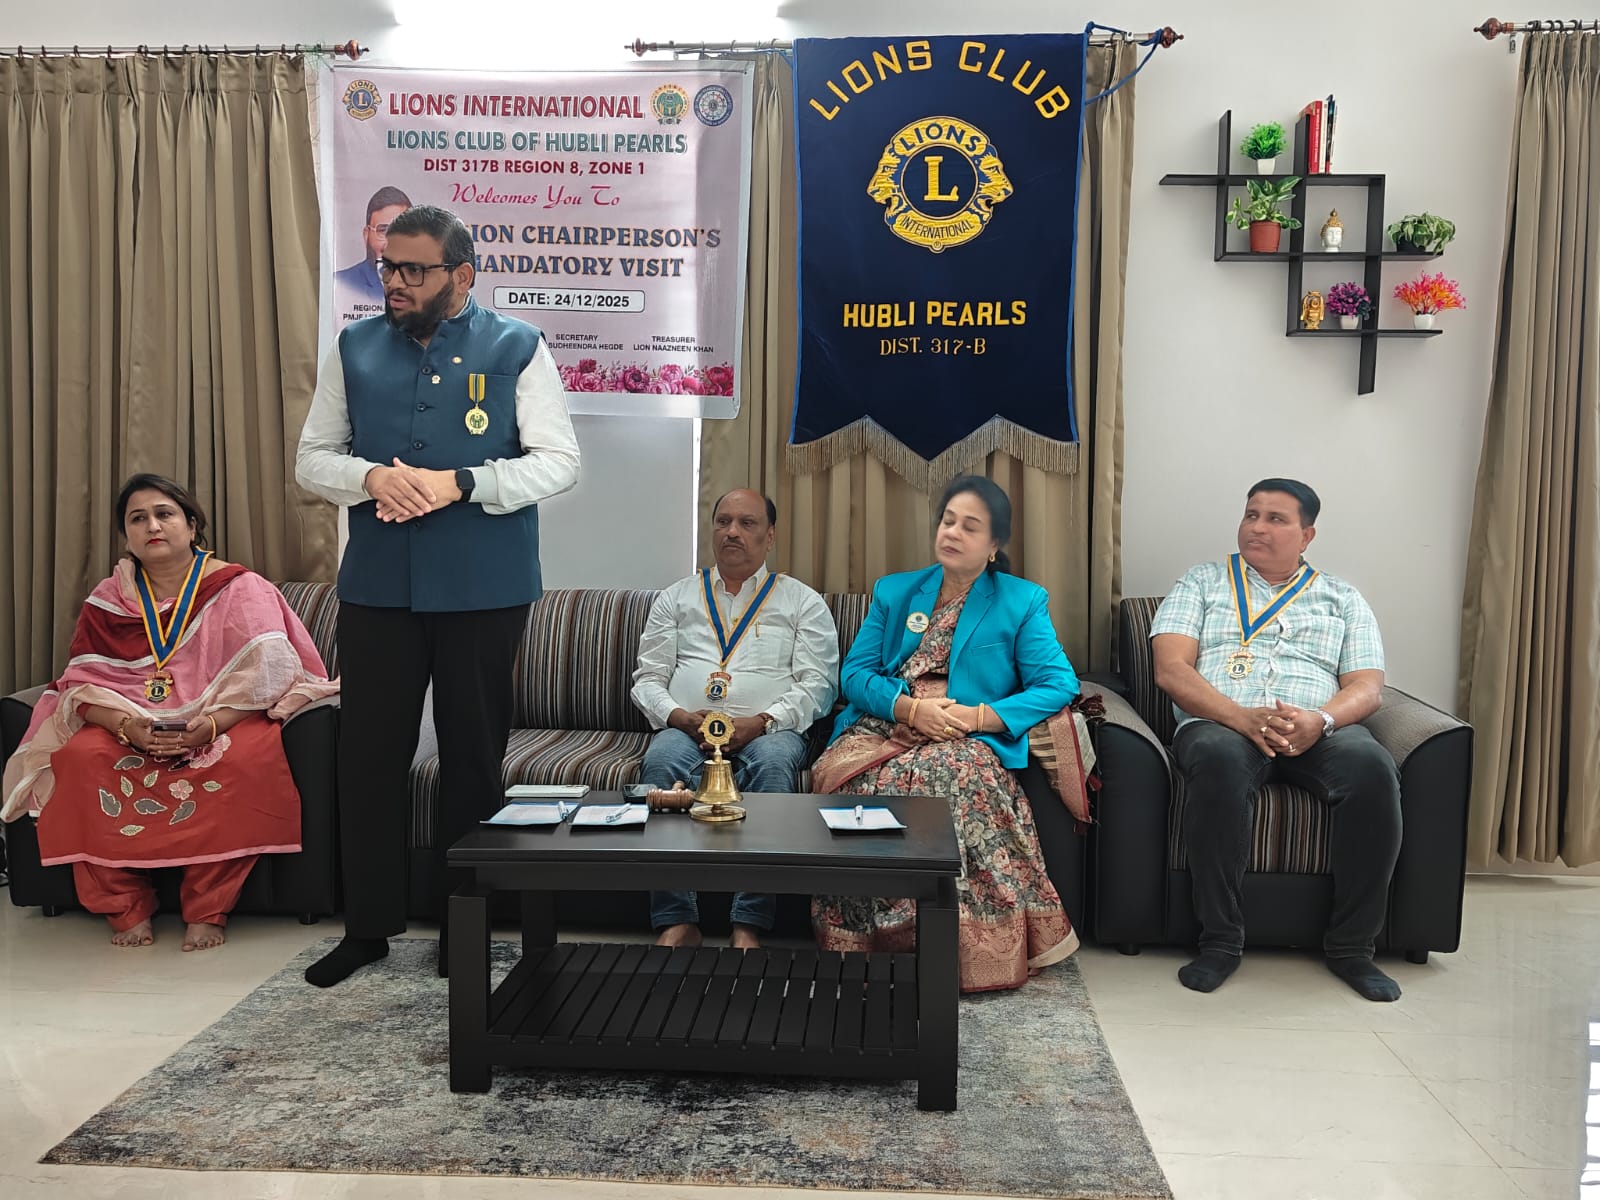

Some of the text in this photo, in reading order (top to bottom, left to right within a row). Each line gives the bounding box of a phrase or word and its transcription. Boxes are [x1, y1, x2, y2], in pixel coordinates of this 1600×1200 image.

[351, 81, 374, 90] LIONS
[809, 40, 933, 121] LIONS
[958, 40, 1070, 119] CLUB
[358, 92, 368, 106] L
[389, 93, 456, 116] LIONS
[463, 94, 645, 118] INTERNATIONAL
[386, 130, 688, 153] LIONS CLUB OF HUBLI PEARLS
[899, 123, 982, 153] LIONS
[424, 158, 645, 176] DIST 317B REGION 8, ZONE 1
[924, 155, 959, 202] L
[449, 183, 620, 209] Welcomes You To
[521, 225, 721, 248] CHAIRPERSON'S
[900, 215, 975, 239] INTERNATIONAL
[619, 257, 684, 277] VISIT
[508, 292, 630, 308] DATE: 24/12/2025
[843, 300, 1027, 327] HUBLI PEARLS
[548, 342, 624, 351] SUDHEENDRA HEGDE
[652, 344, 691, 352] NAAZNEEN
[880, 337, 986, 355] DIST. 317-B
[155, 687, 162, 695] L
[713, 686, 720, 695] L
[713, 722, 723, 735] L
